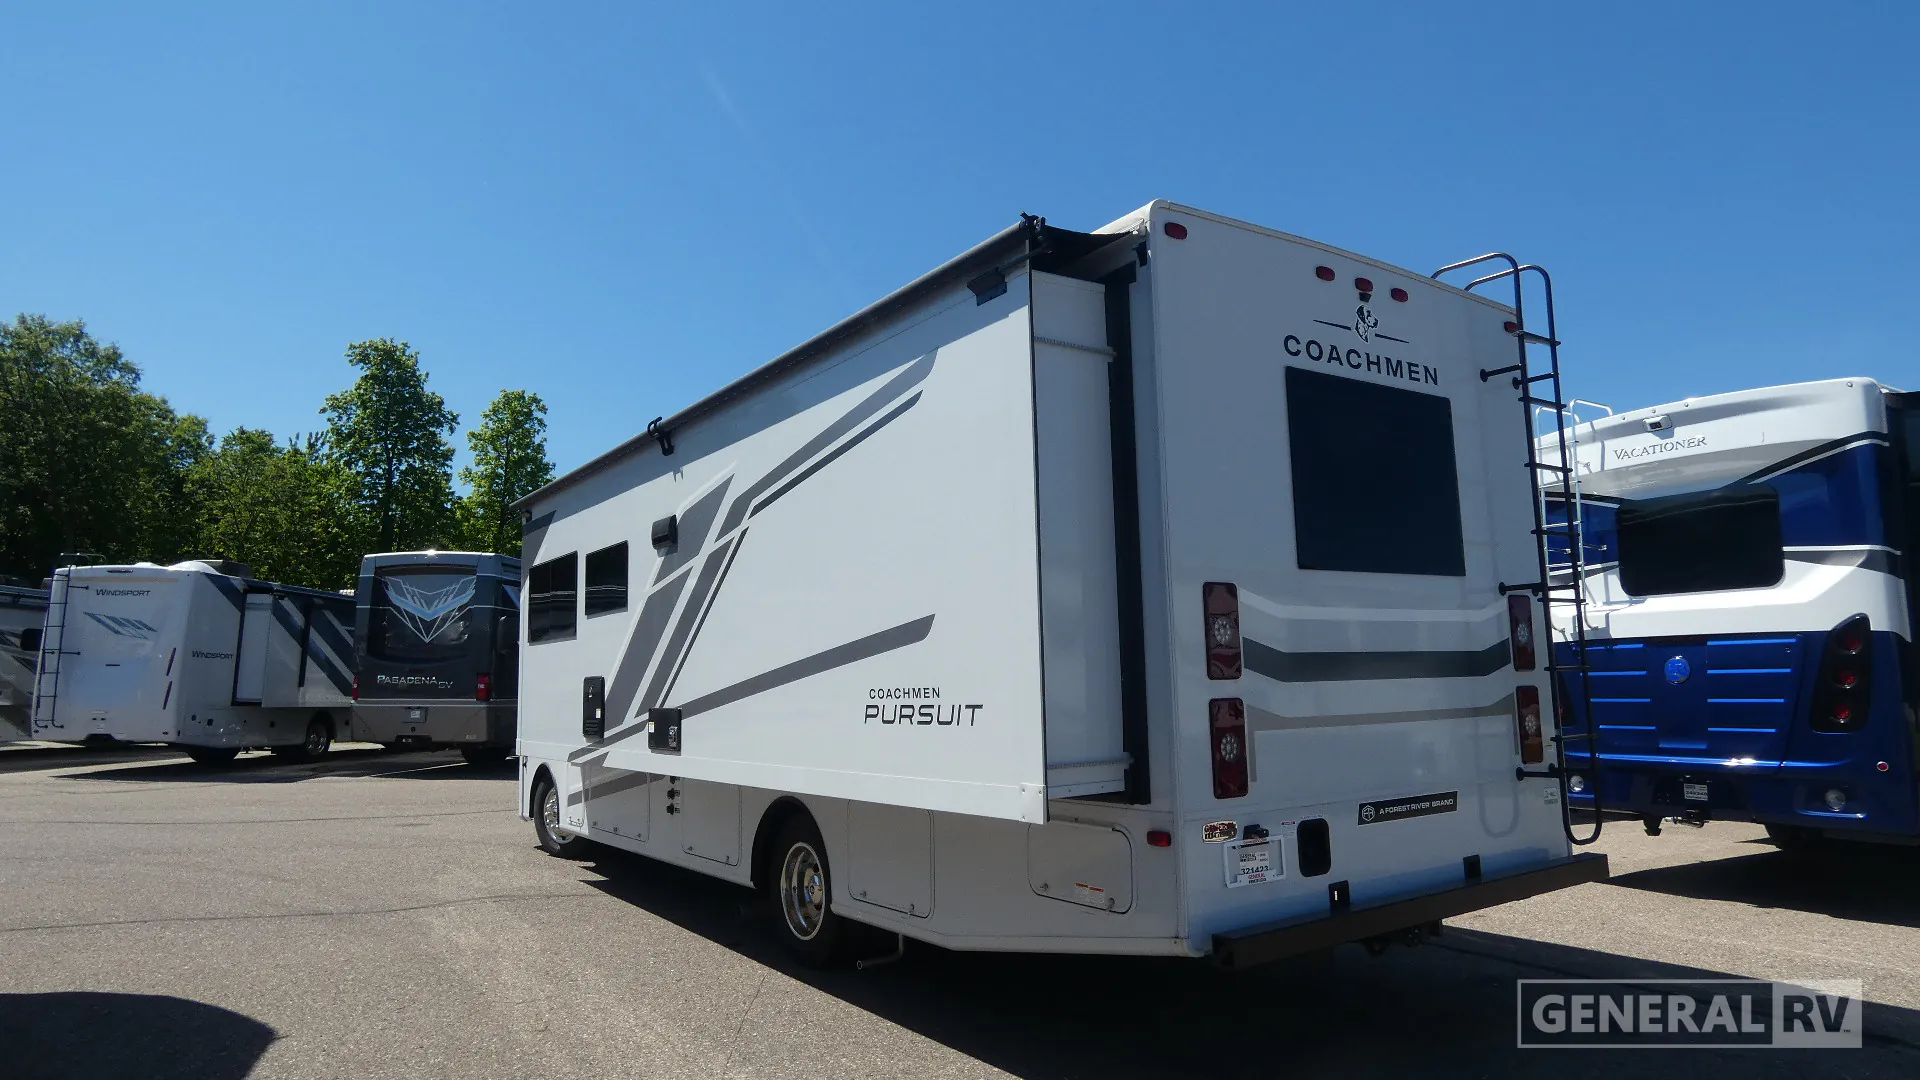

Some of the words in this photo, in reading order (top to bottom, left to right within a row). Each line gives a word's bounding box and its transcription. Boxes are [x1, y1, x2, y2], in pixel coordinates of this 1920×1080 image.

[1283, 334, 1439, 386] COACHMEN
[1613, 436, 1708, 460] VACATIONER
[96, 589, 151, 597] WINDSPORT
[192, 650, 234, 660] WINDSPORT
[377, 675, 437, 685] PASADENA
[869, 687, 941, 700] COACHMEN
[864, 704, 984, 726] PURSUIT
[1385, 804, 1411, 814] FOREST
[1411, 801, 1430, 810] RIVER
[1431, 798, 1454, 808] BRAND
